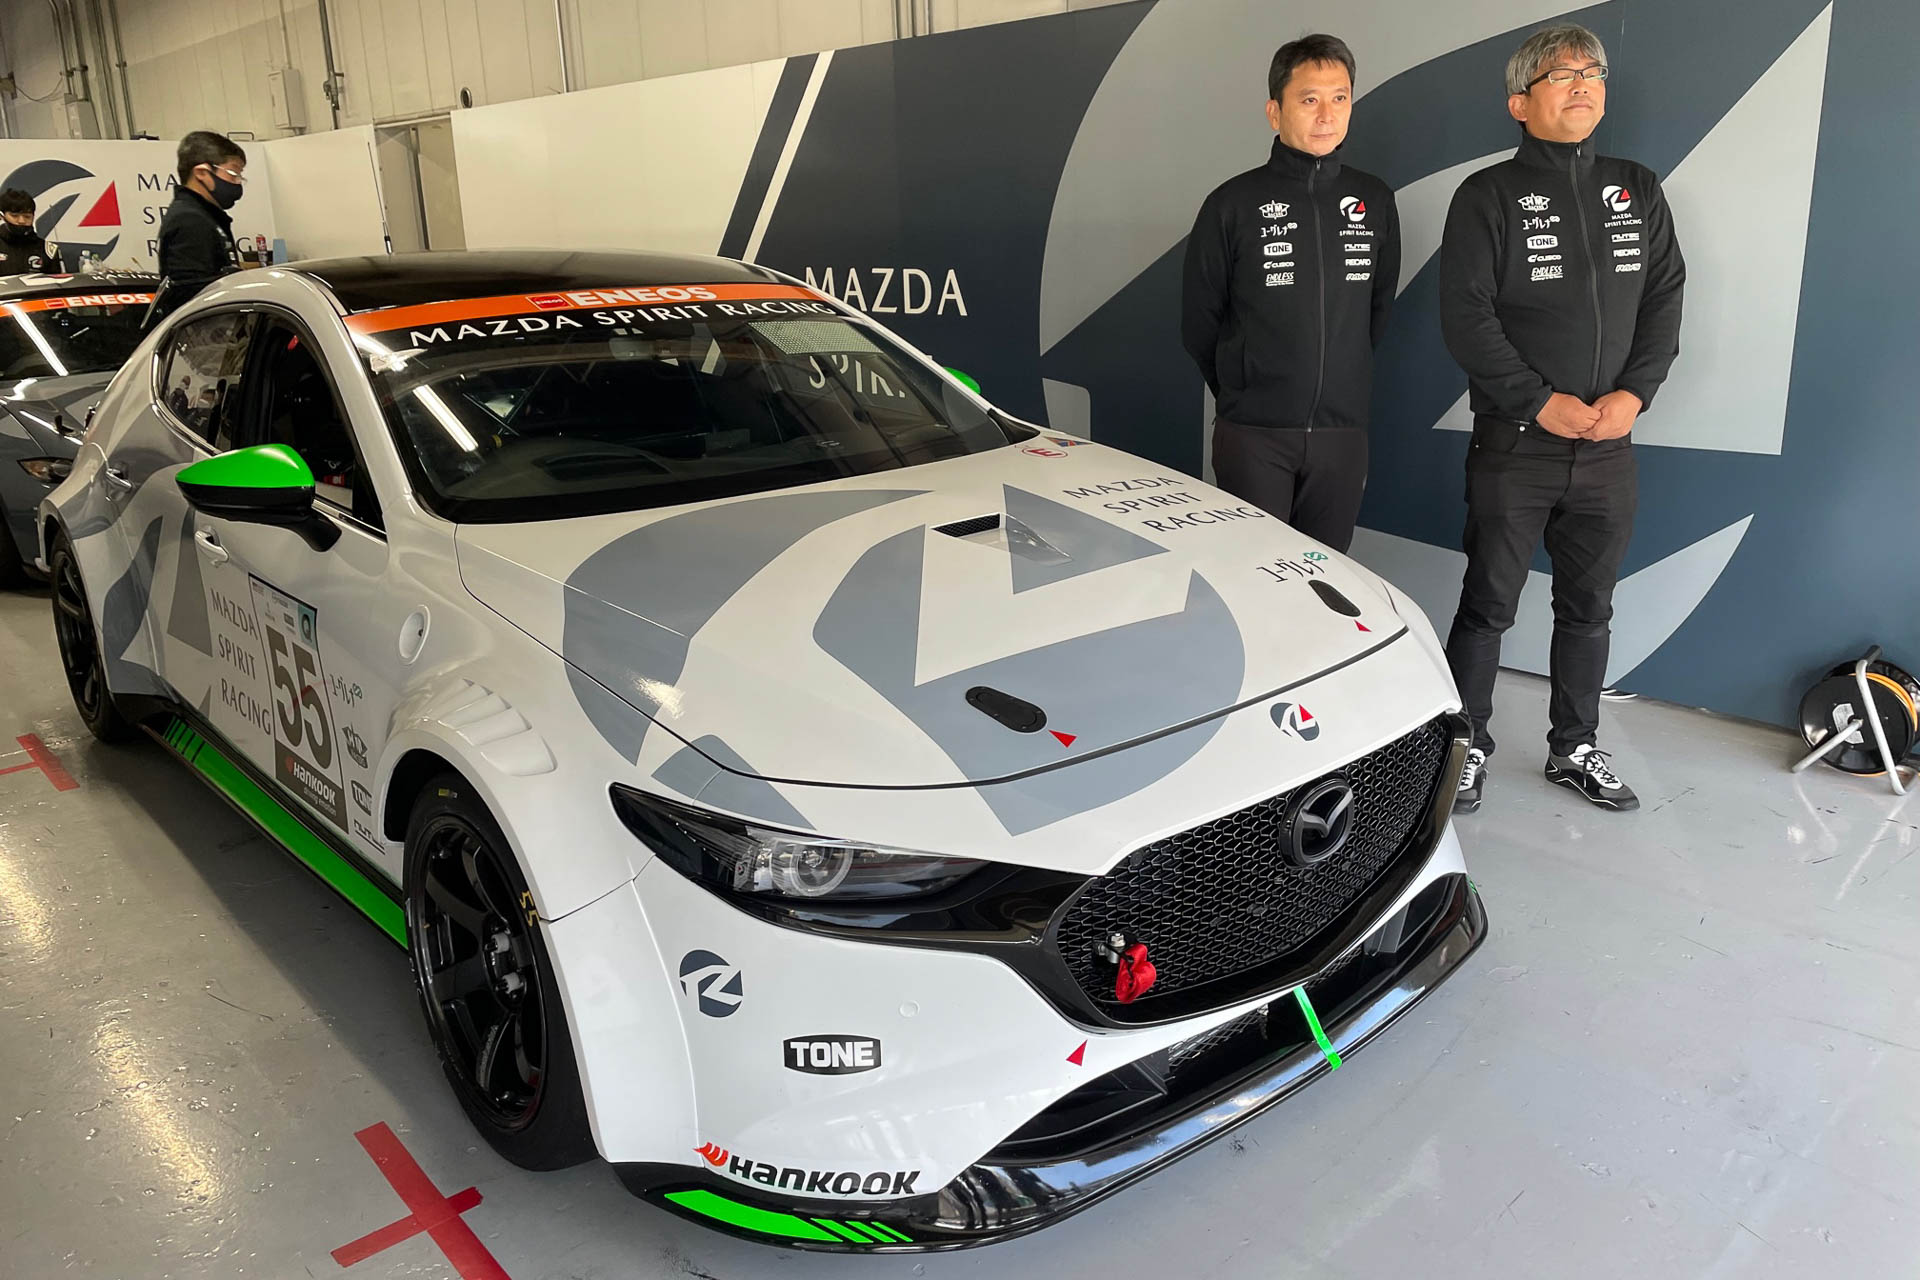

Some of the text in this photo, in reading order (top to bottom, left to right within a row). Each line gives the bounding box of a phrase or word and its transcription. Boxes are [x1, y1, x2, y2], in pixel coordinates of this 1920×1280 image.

[1604, 218, 1642, 228] SPIRIT RACING
[1611, 212, 1632, 220] MAZDA
[1266, 244, 1290, 253] TONE
[1529, 237, 1556, 247] TONE
[1266, 272, 1294, 281] ENDLESS
[1531, 265, 1563, 275] ENDLESS
[66, 293, 152, 308] ENEOS
[566, 287, 718, 307] ENEOS
[805, 266, 968, 317] MAZDA
[409, 301, 837, 347] MAZDA SPIRIT RACING
[1063, 476, 1184, 499] MAZDA
[1103, 491, 1202, 515] SPIRIT
[1142, 506, 1266, 533] RACING
[210, 587, 259, 641] MAZDA
[301, 613, 313, 644] Q
[218, 633, 256, 681] SPIRIT
[221, 677, 271, 736] RACING
[266, 624, 332, 770] 55
[790, 1041, 875, 1068] TONE
